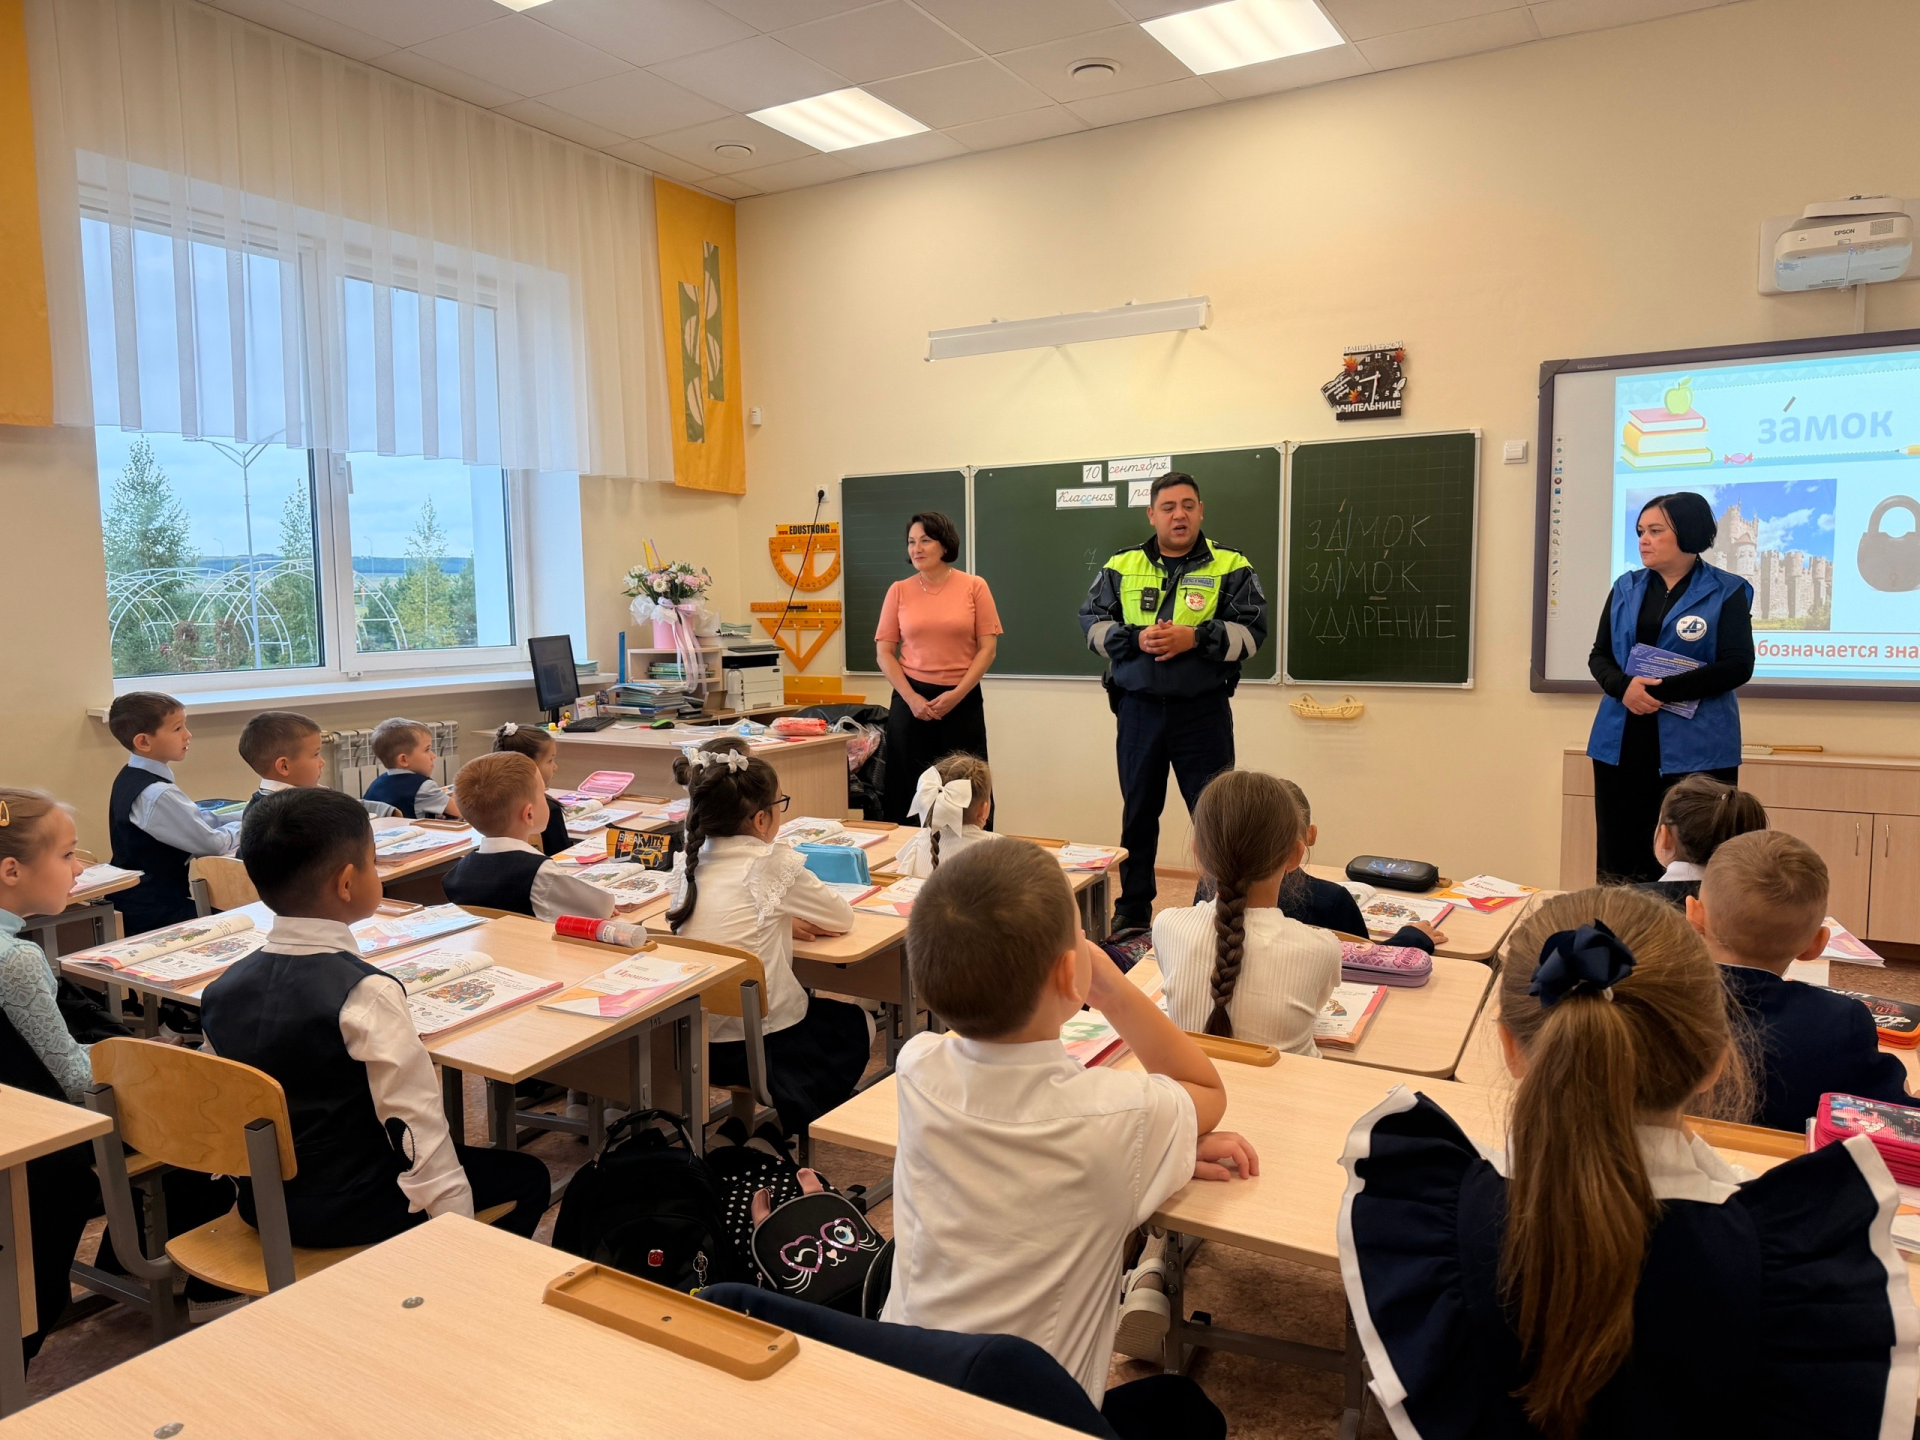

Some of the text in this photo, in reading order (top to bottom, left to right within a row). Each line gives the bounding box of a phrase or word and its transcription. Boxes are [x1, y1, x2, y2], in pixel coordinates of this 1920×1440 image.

[1834, 228, 1855, 236] EPSON
[1336, 400, 1401, 413] УЧИТЕЛЬНИЦЕ
[1085, 466, 1100, 479] 10
[1057, 491, 1114, 503] Классная
[1305, 605, 1456, 644] УДАРЕНИЕ
[1754, 639, 1878, 658] бозначается
[619, 832, 644, 848] BREAK
